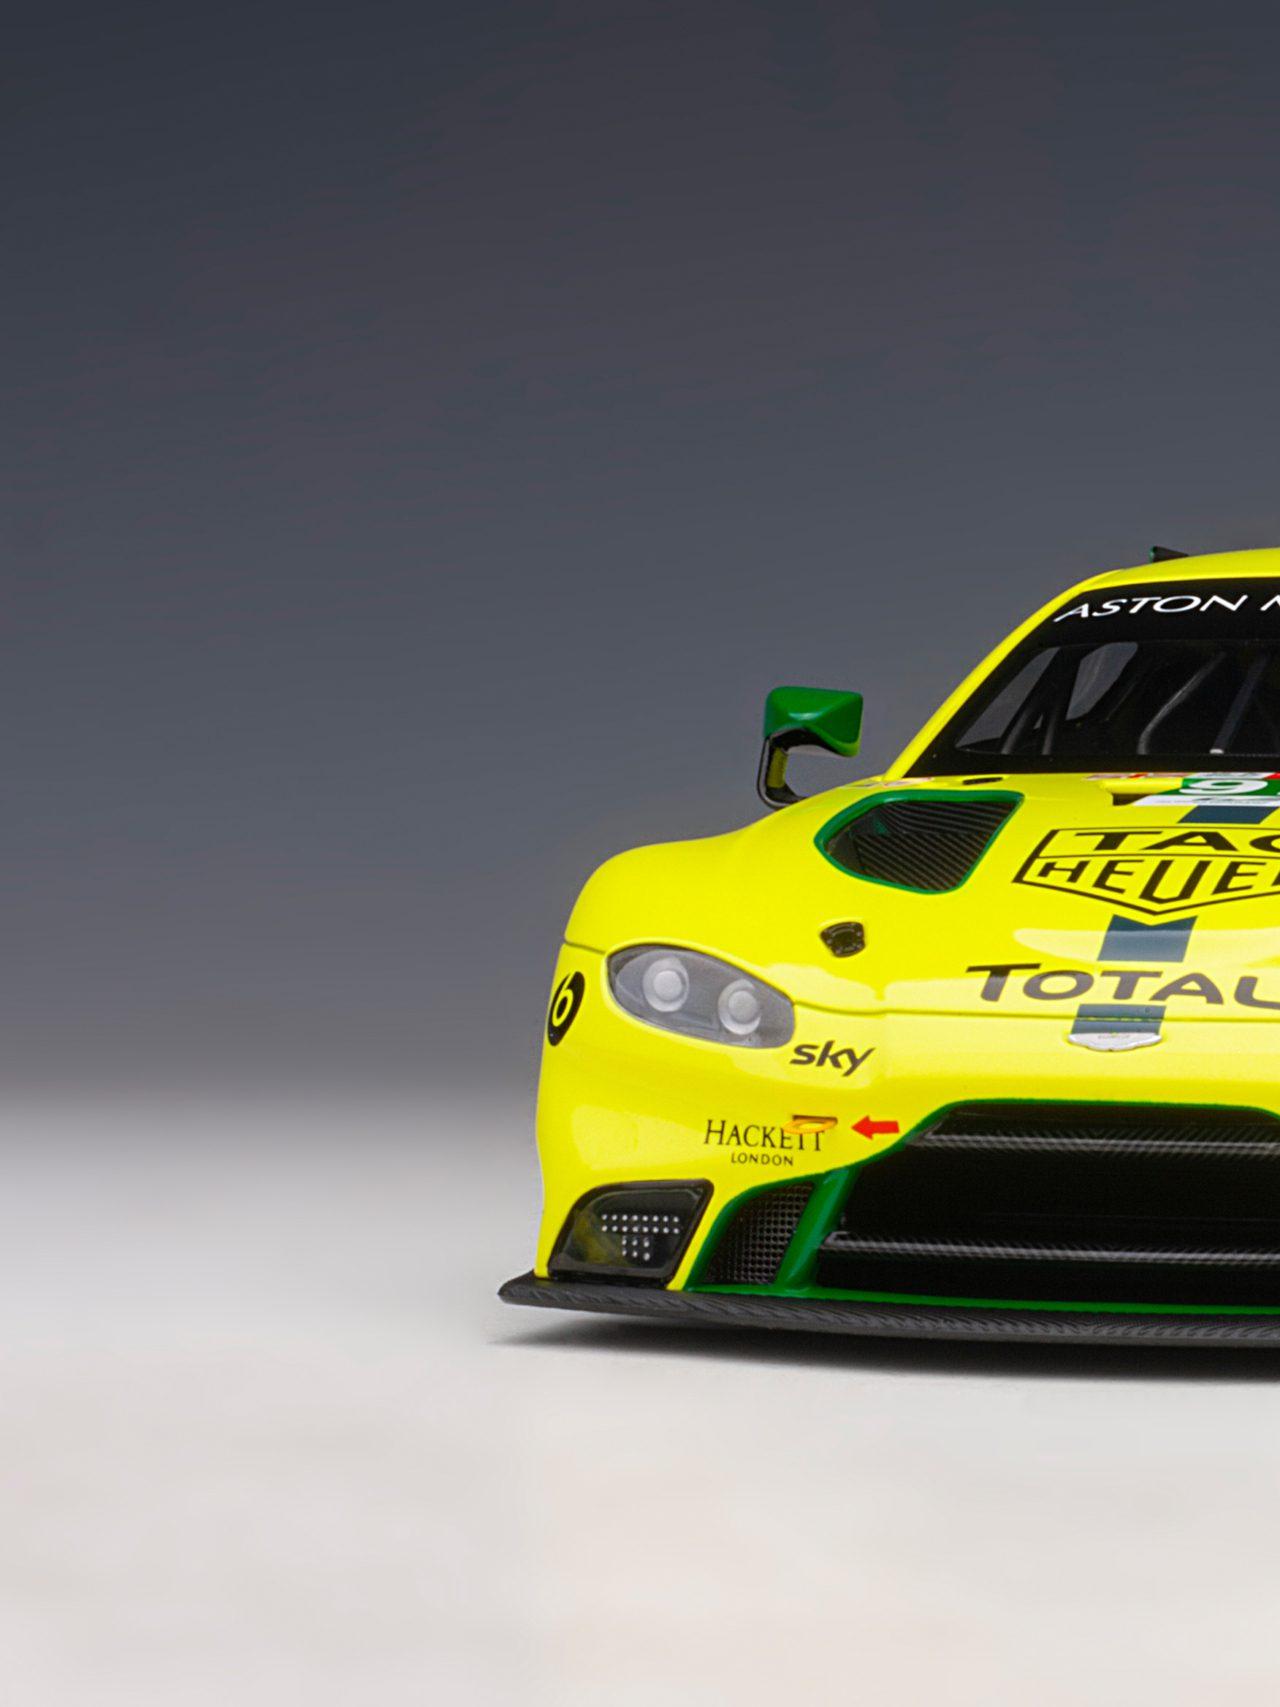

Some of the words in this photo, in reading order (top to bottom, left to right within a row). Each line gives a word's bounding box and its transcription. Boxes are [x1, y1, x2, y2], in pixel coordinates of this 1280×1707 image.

[1052, 594, 1248, 622] ASTON
[790, 1040, 875, 1076] sky
[731, 1152, 794, 1167] LONDON
